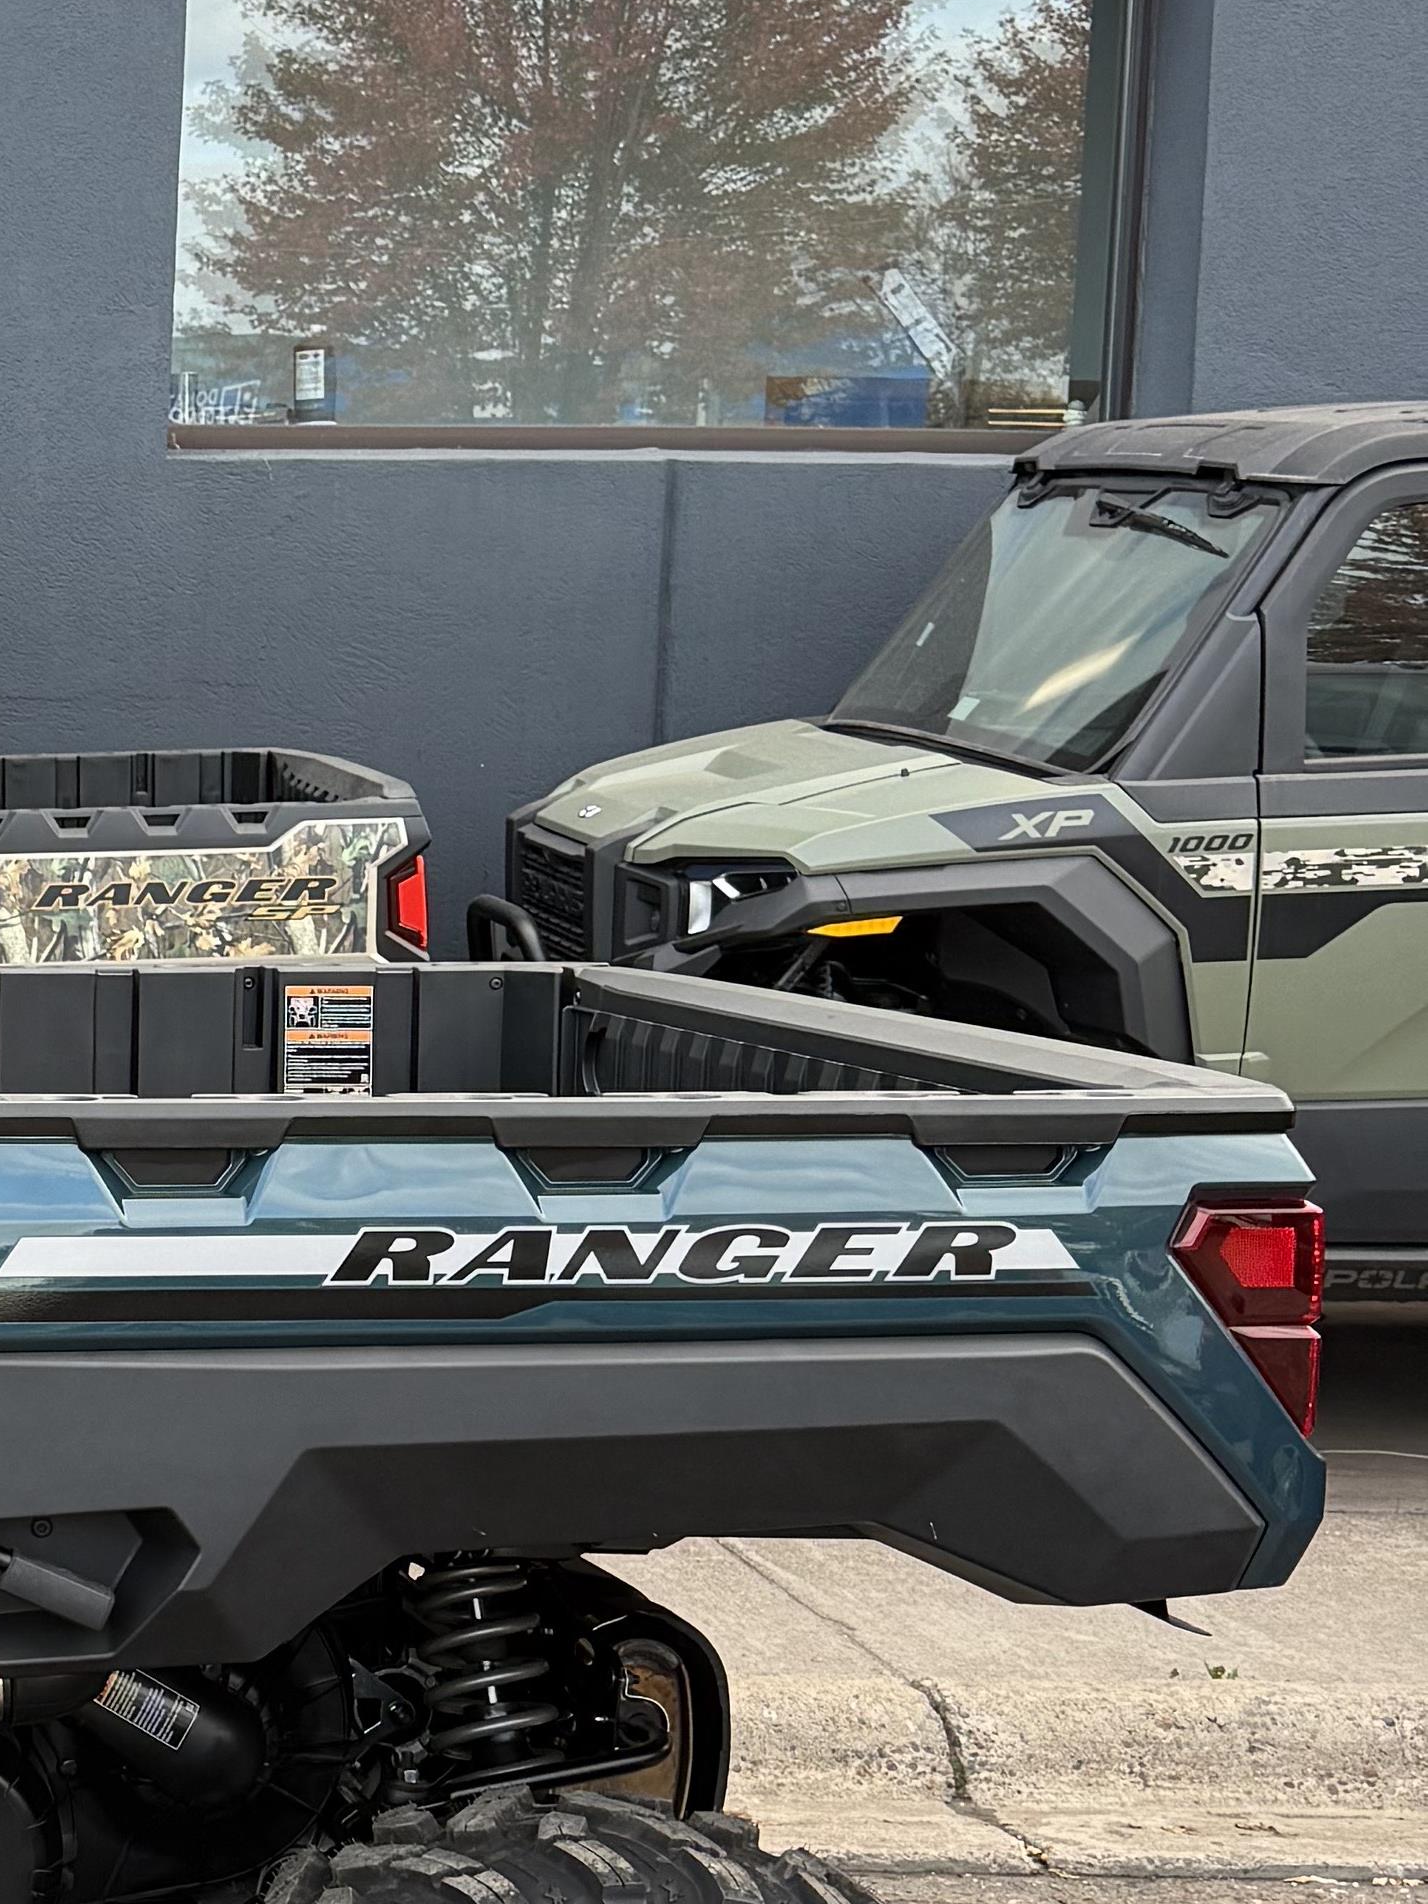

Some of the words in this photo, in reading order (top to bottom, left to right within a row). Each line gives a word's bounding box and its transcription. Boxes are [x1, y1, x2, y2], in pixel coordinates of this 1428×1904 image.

[998, 809, 1095, 841] XP
[1168, 833, 1255, 854] 1000
[32, 877, 337, 909] RANGER
[245, 904, 340, 921] SP
[324, 1224, 1017, 1286] RANGER
